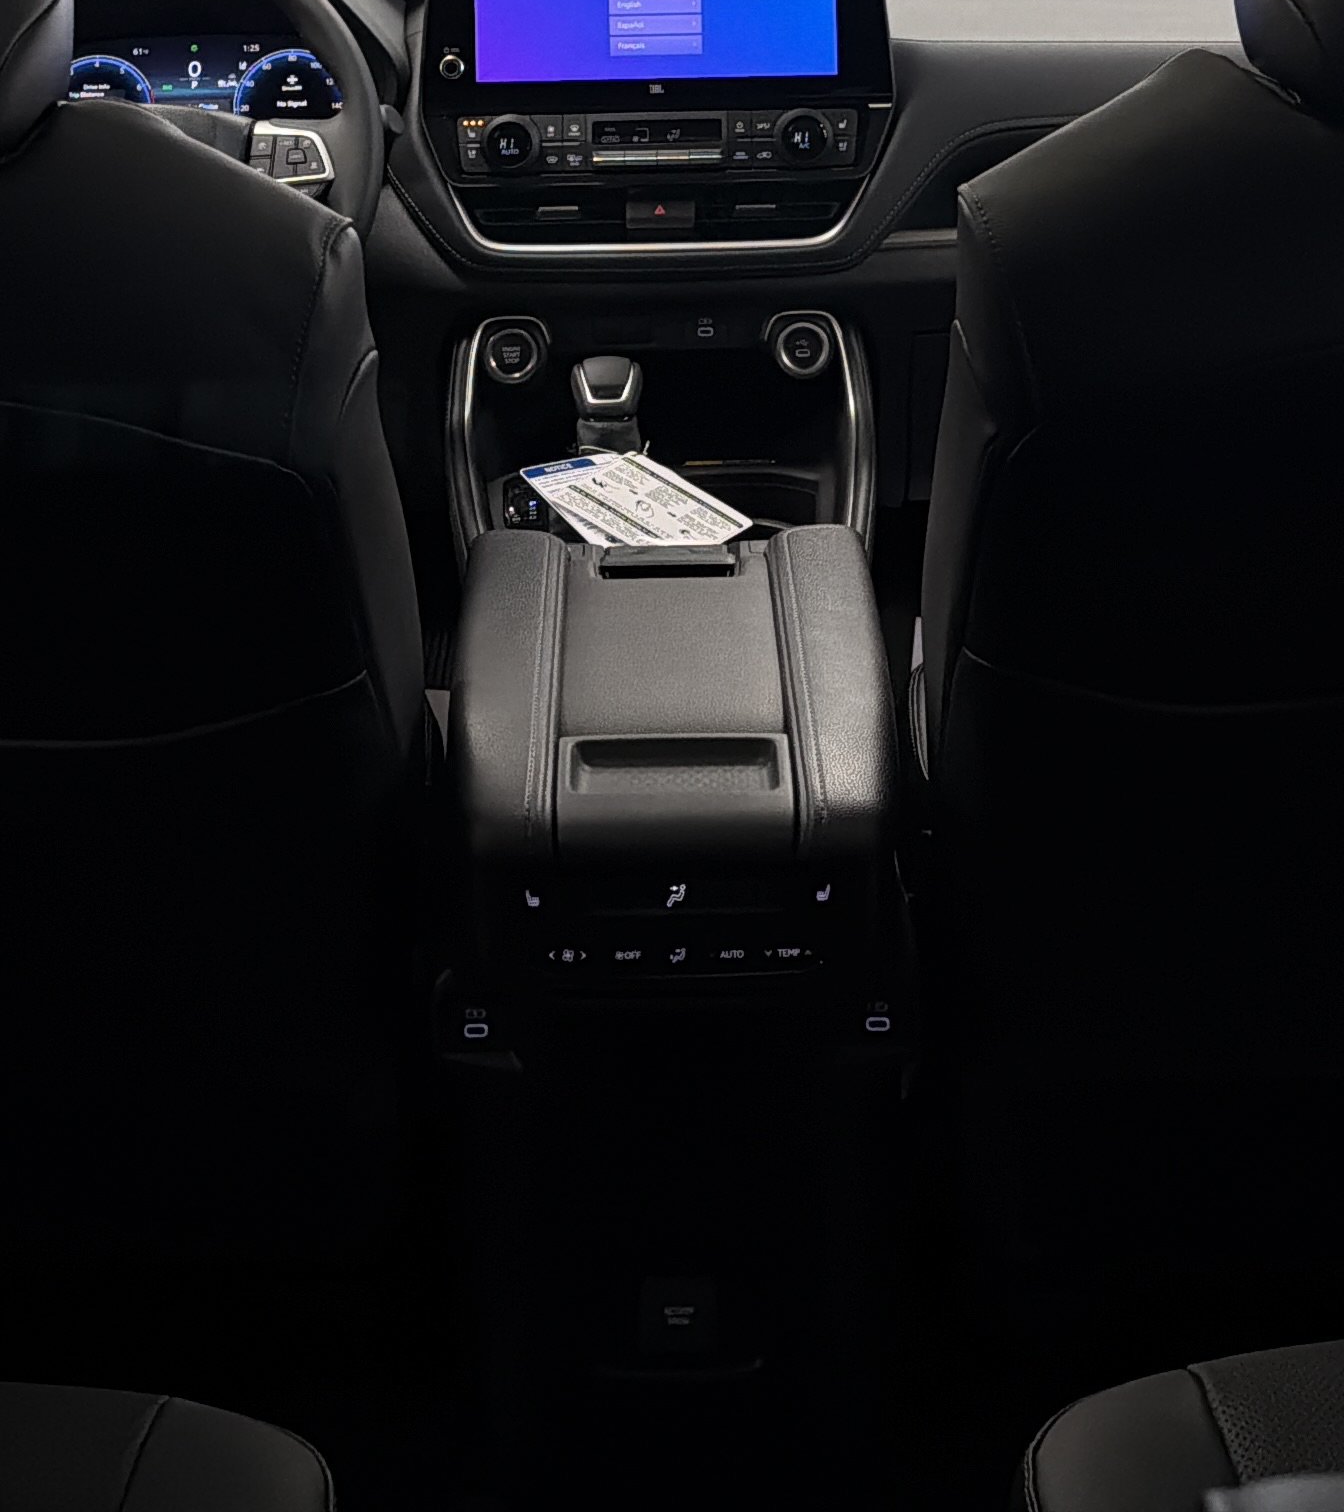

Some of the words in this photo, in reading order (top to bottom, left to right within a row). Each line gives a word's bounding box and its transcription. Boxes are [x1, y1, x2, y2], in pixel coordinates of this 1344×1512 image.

[617, 1, 642, 10] English
[243, 44, 260, 52] 1:25
[617, 41, 645, 50] Français
[188, 60, 202, 78] 0
[136, 83, 142, 91] 6
[191, 80, 198, 89] P
[649, 84, 665, 94] JBL
[240, 104, 250, 112] 20
[287, 98, 307, 109] Signal
[794, 131, 809, 143] HI
[499, 137, 515, 150] HI
[543, 463, 573, 472] NOTICE
[624, 951, 642, 960] OFF
[720, 950, 745, 959] AUTO
[777, 948, 801, 958] TEMP
